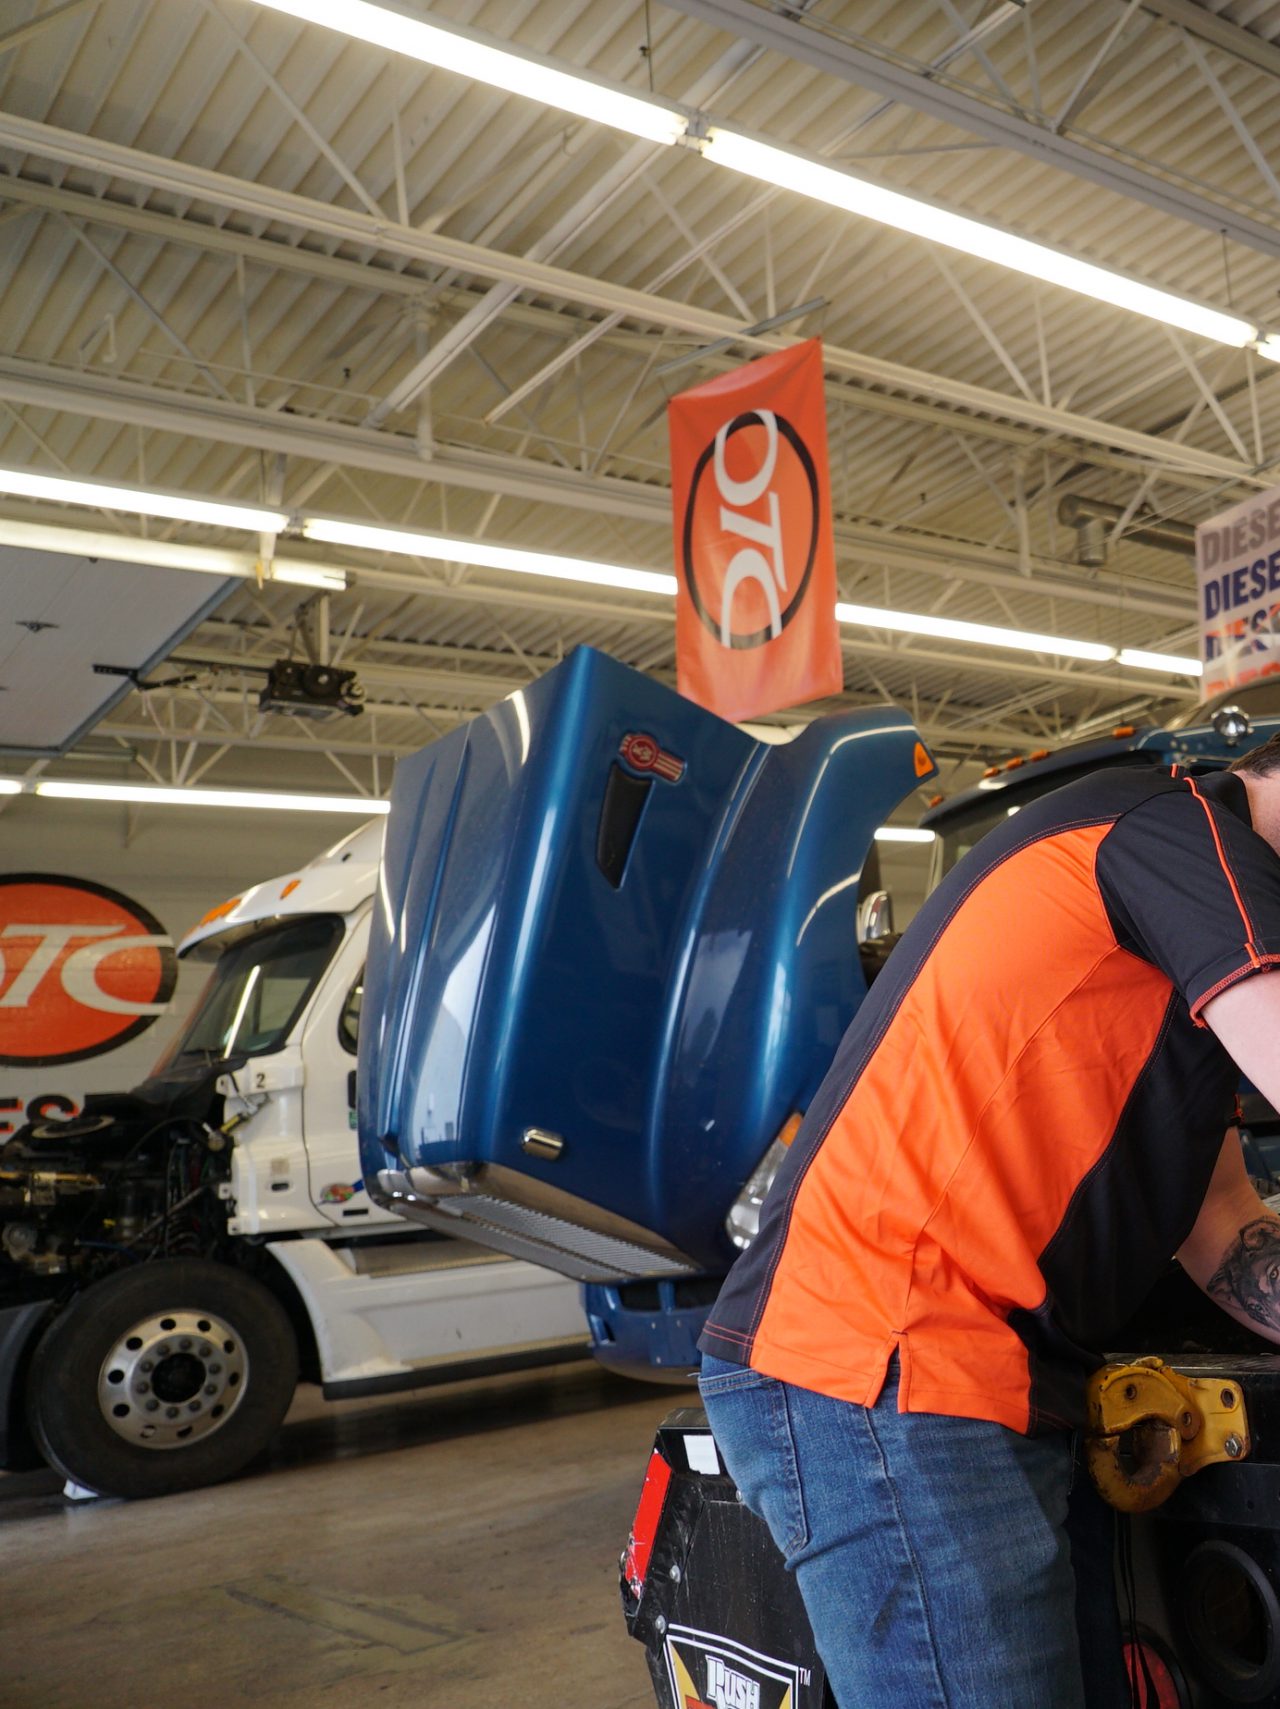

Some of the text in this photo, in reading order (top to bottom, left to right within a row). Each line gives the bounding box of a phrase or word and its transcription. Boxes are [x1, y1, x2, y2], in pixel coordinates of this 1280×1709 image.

[714, 409, 787, 649] OTC
[0, 924, 174, 1016] TC
[256, 1073, 266, 1089] 2
[799, 1667, 811, 1687] TM
